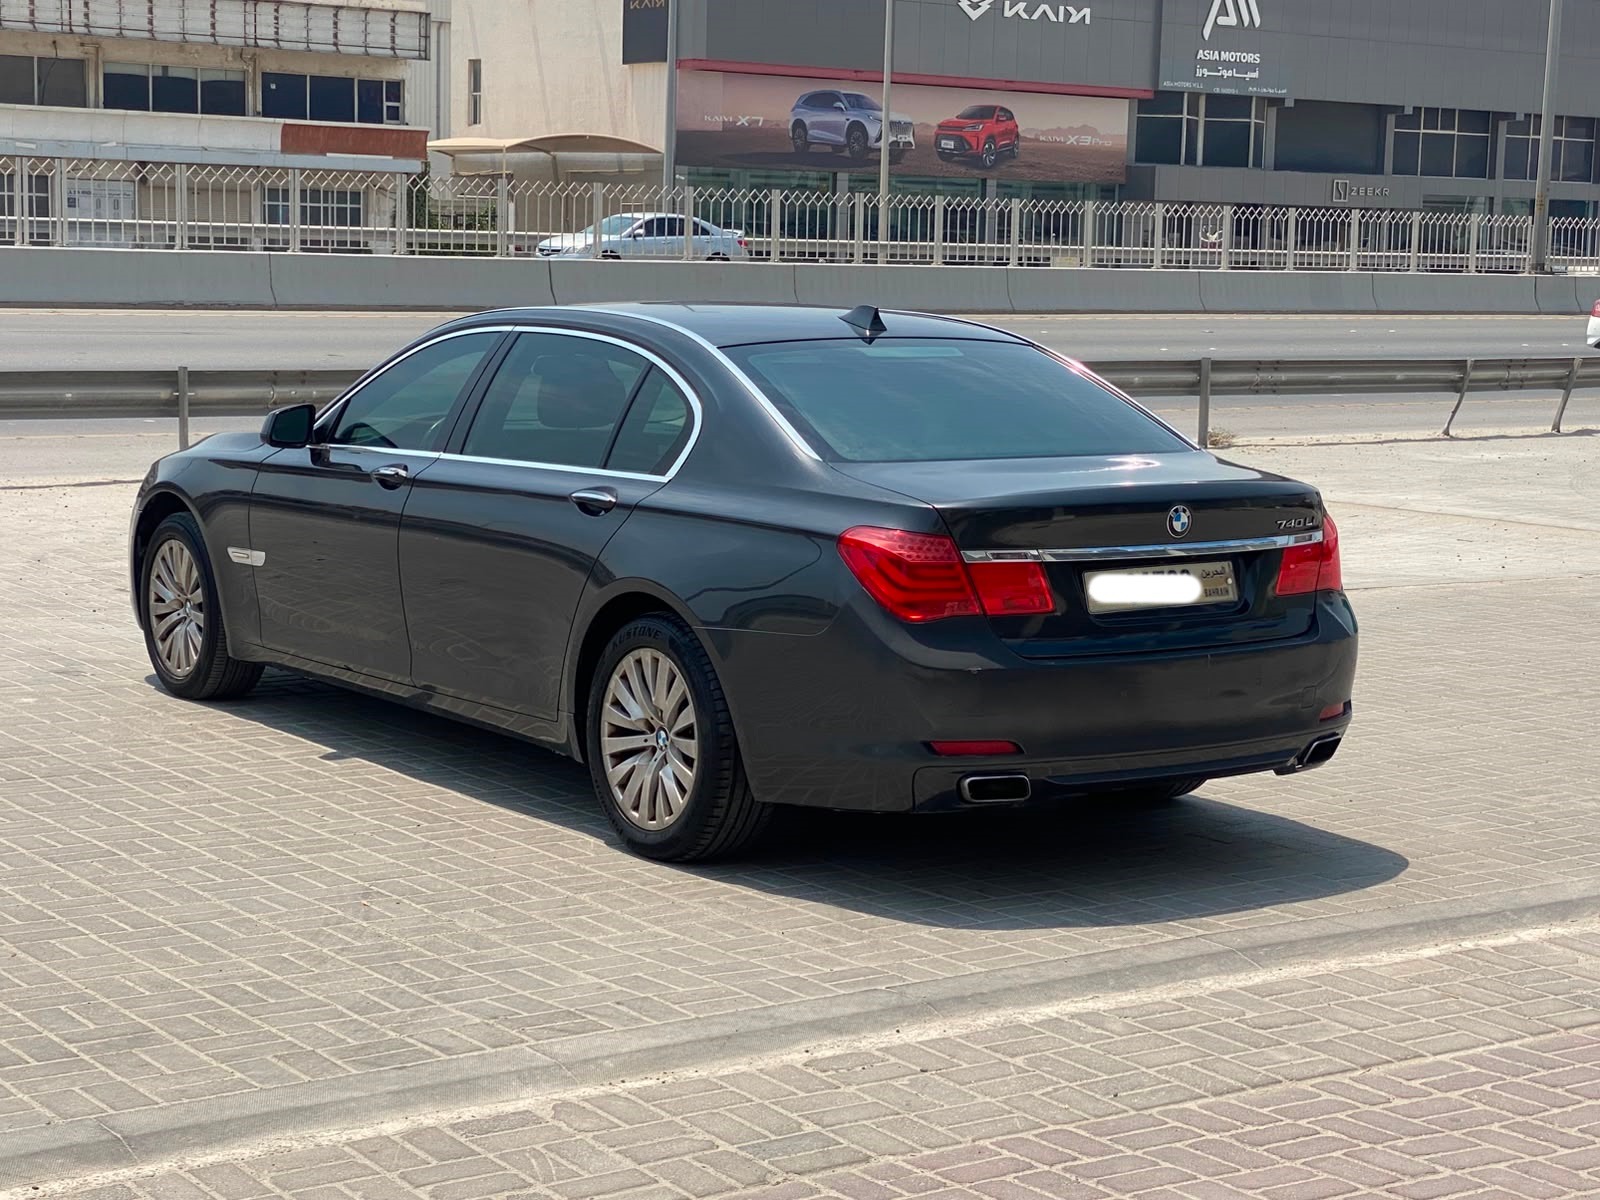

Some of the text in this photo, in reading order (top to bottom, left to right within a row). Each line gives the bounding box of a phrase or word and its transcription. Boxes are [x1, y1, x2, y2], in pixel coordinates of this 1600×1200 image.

[1196, 49, 1261, 64] ASIA MOTORS
[736, 115, 764, 127] X7
[1350, 186, 1391, 197] ZEEKR
[1201, 566, 1226, 579] البحرين
[1204, 586, 1230, 598] BAHRAIN
